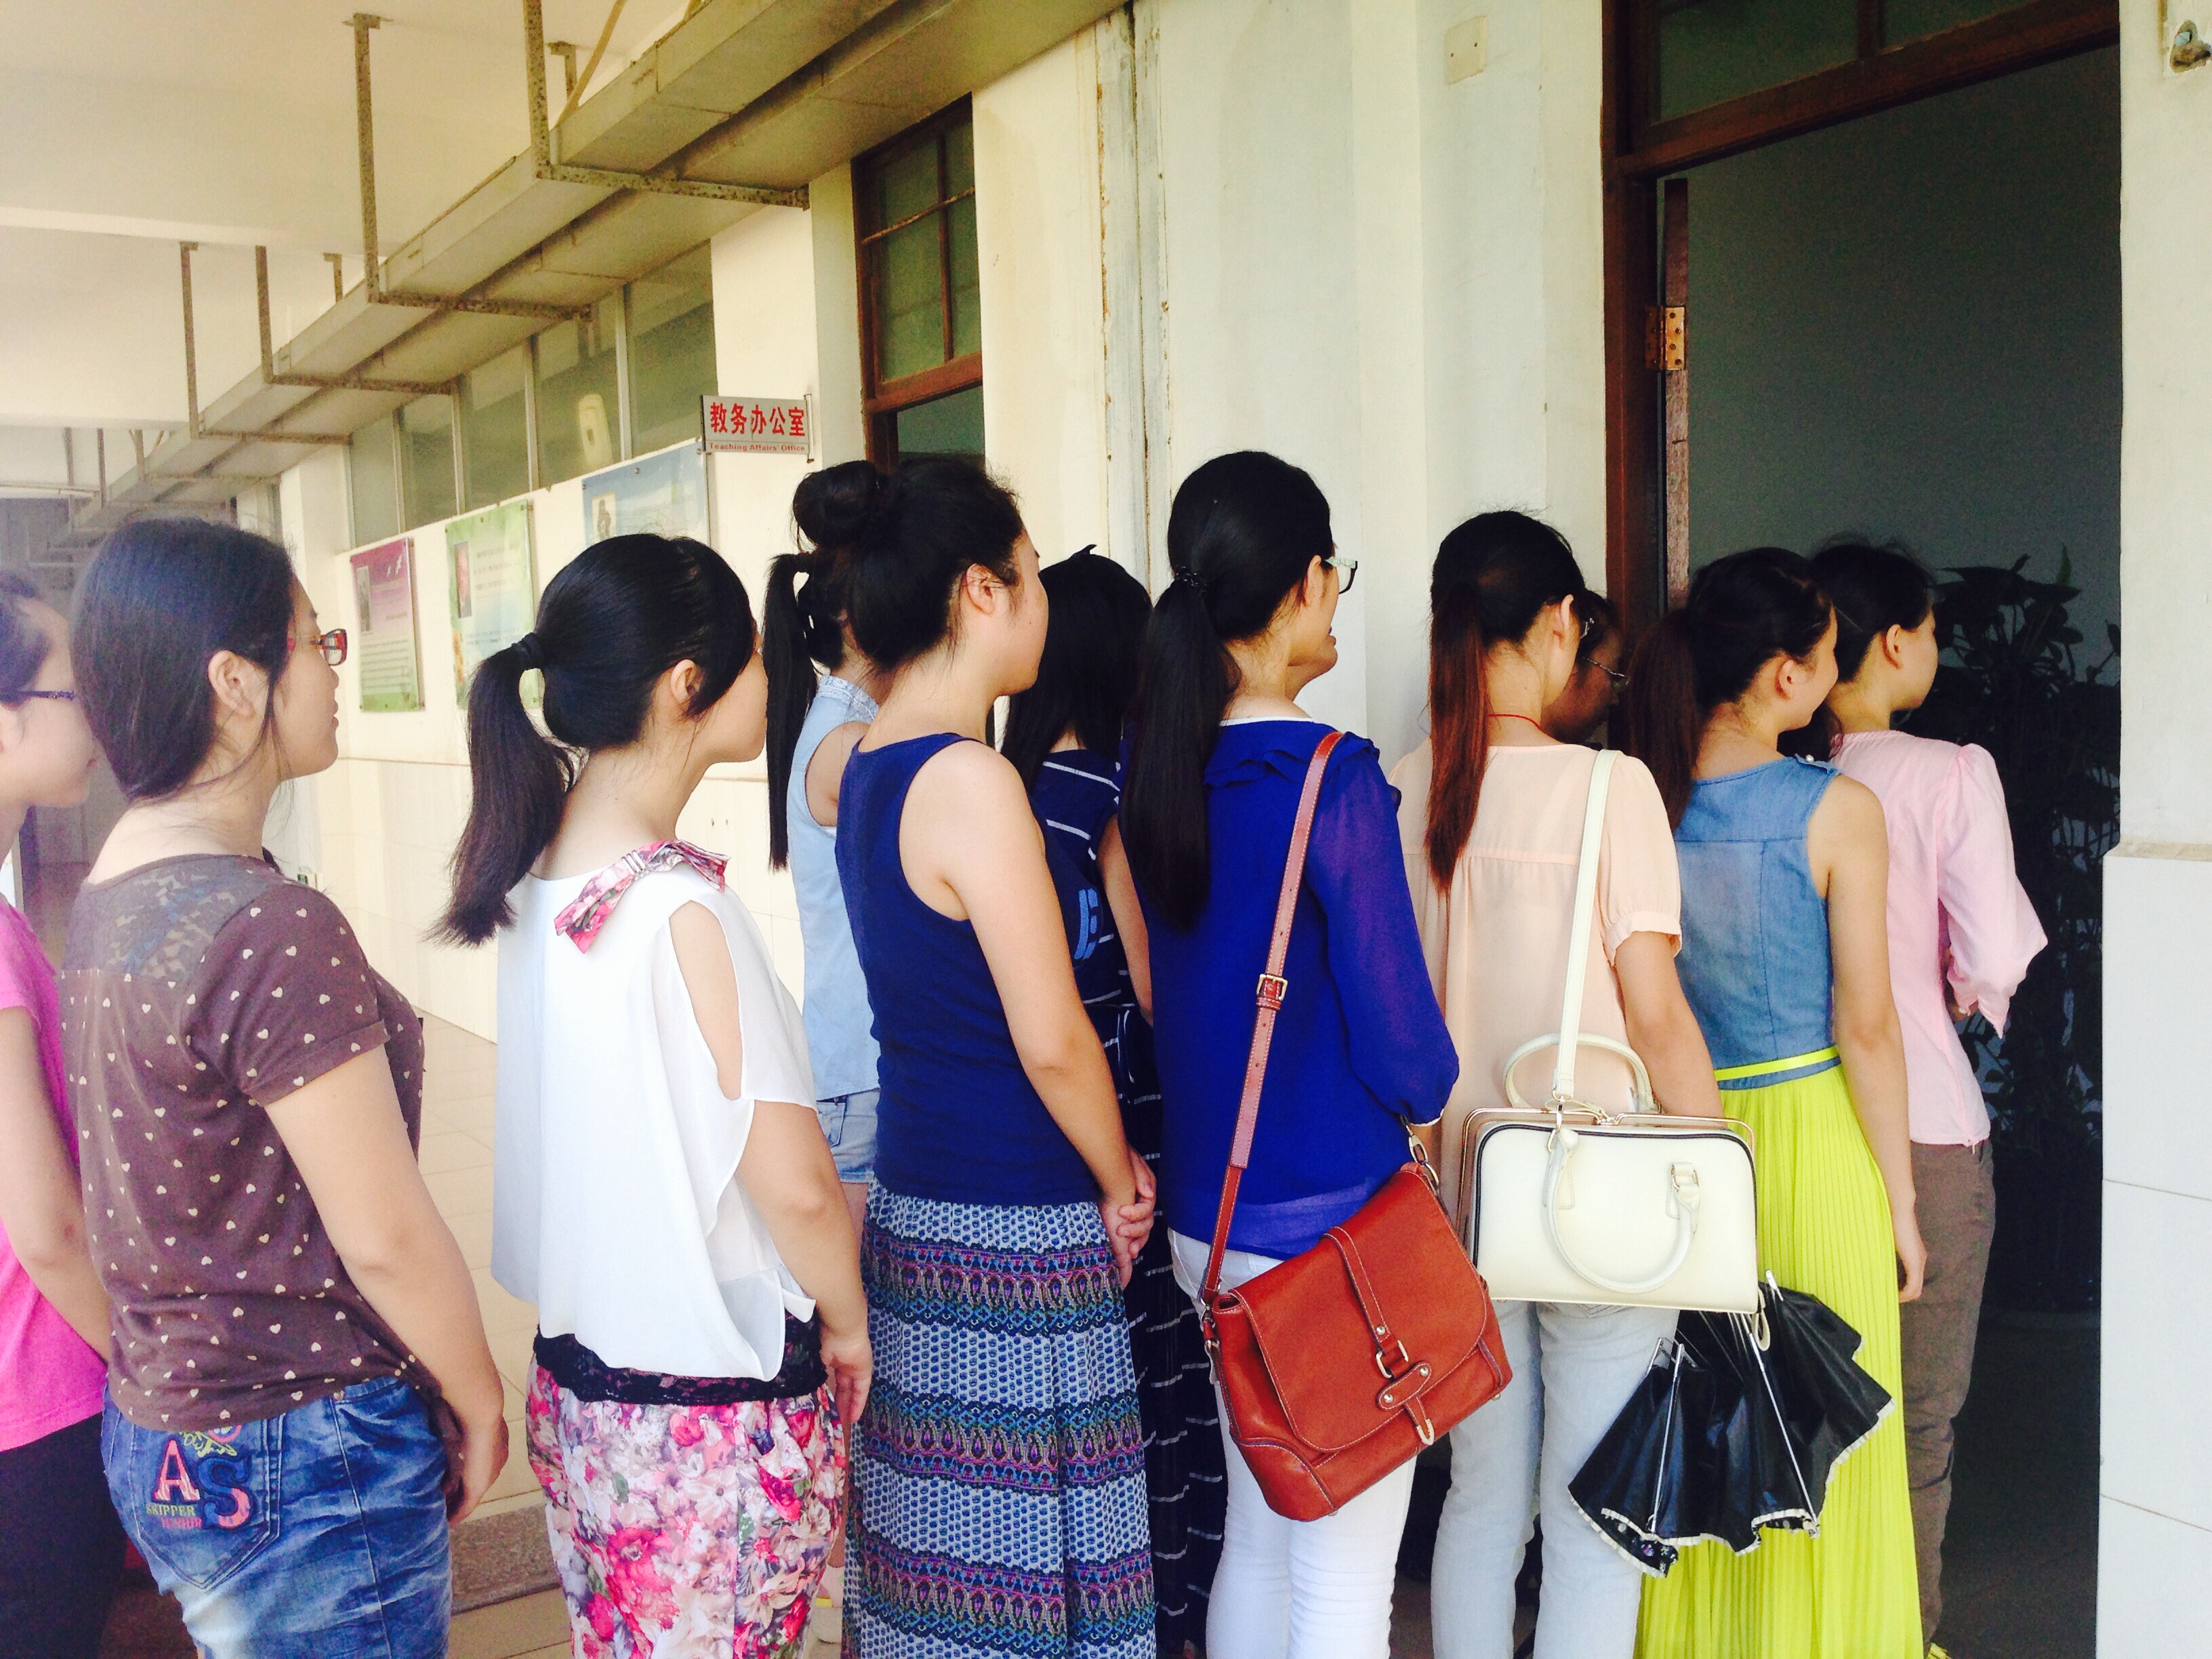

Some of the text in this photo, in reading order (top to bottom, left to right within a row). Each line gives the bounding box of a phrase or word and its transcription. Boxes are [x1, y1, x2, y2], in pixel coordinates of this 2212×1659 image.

[710, 402, 805, 436] 教务办公室
[709, 442, 747, 451] Teaching
[146, 1503, 196, 1517] SKIPPER
